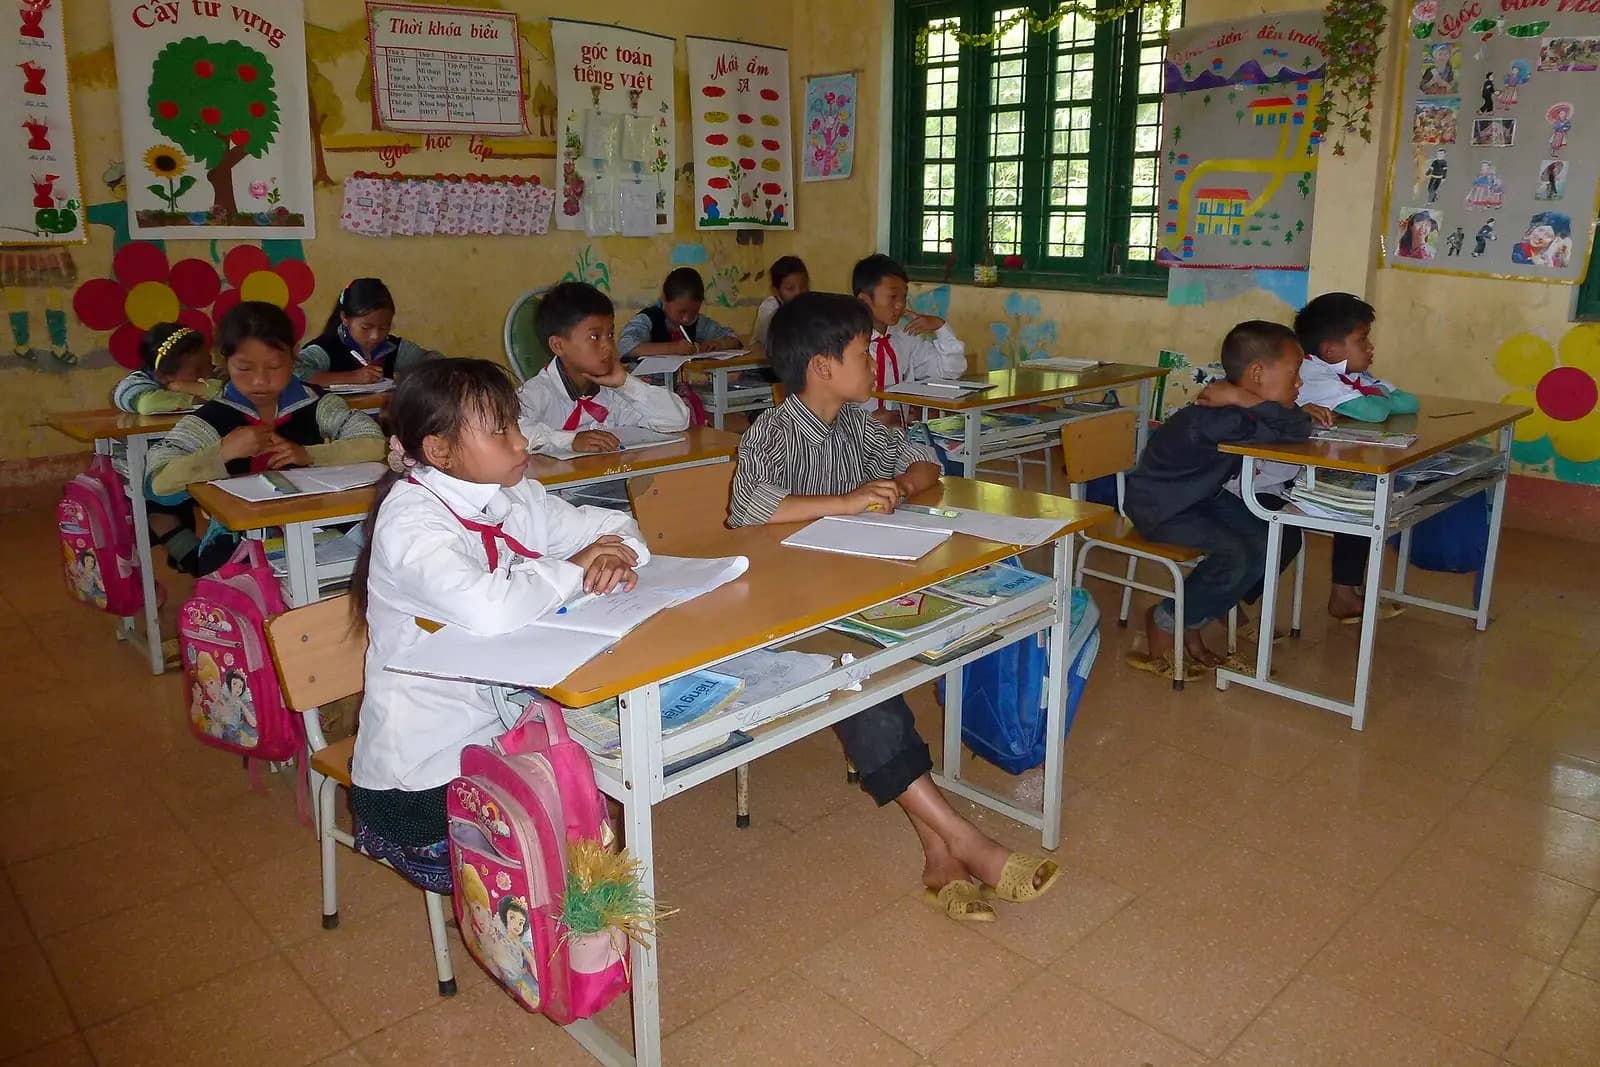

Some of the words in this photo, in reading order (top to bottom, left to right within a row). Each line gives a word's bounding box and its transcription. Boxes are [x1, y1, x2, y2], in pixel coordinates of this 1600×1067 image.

[232, 6, 287, 48] vựng
[390, 17, 423, 35] Thời
[428, 21, 462, 37] khóa
[471, 20, 499, 40] biểu
[1256, 21, 1283, 41] đến
[581, 42, 608, 65] góc
[616, 46, 653, 68] toán
[711, 52, 739, 80] Mái
[574, 63, 614, 90] tiếng
[737, 78, 751, 94] 5A
[425, 134, 452, 153] học
[679, 680, 720, 706] Tiếng
